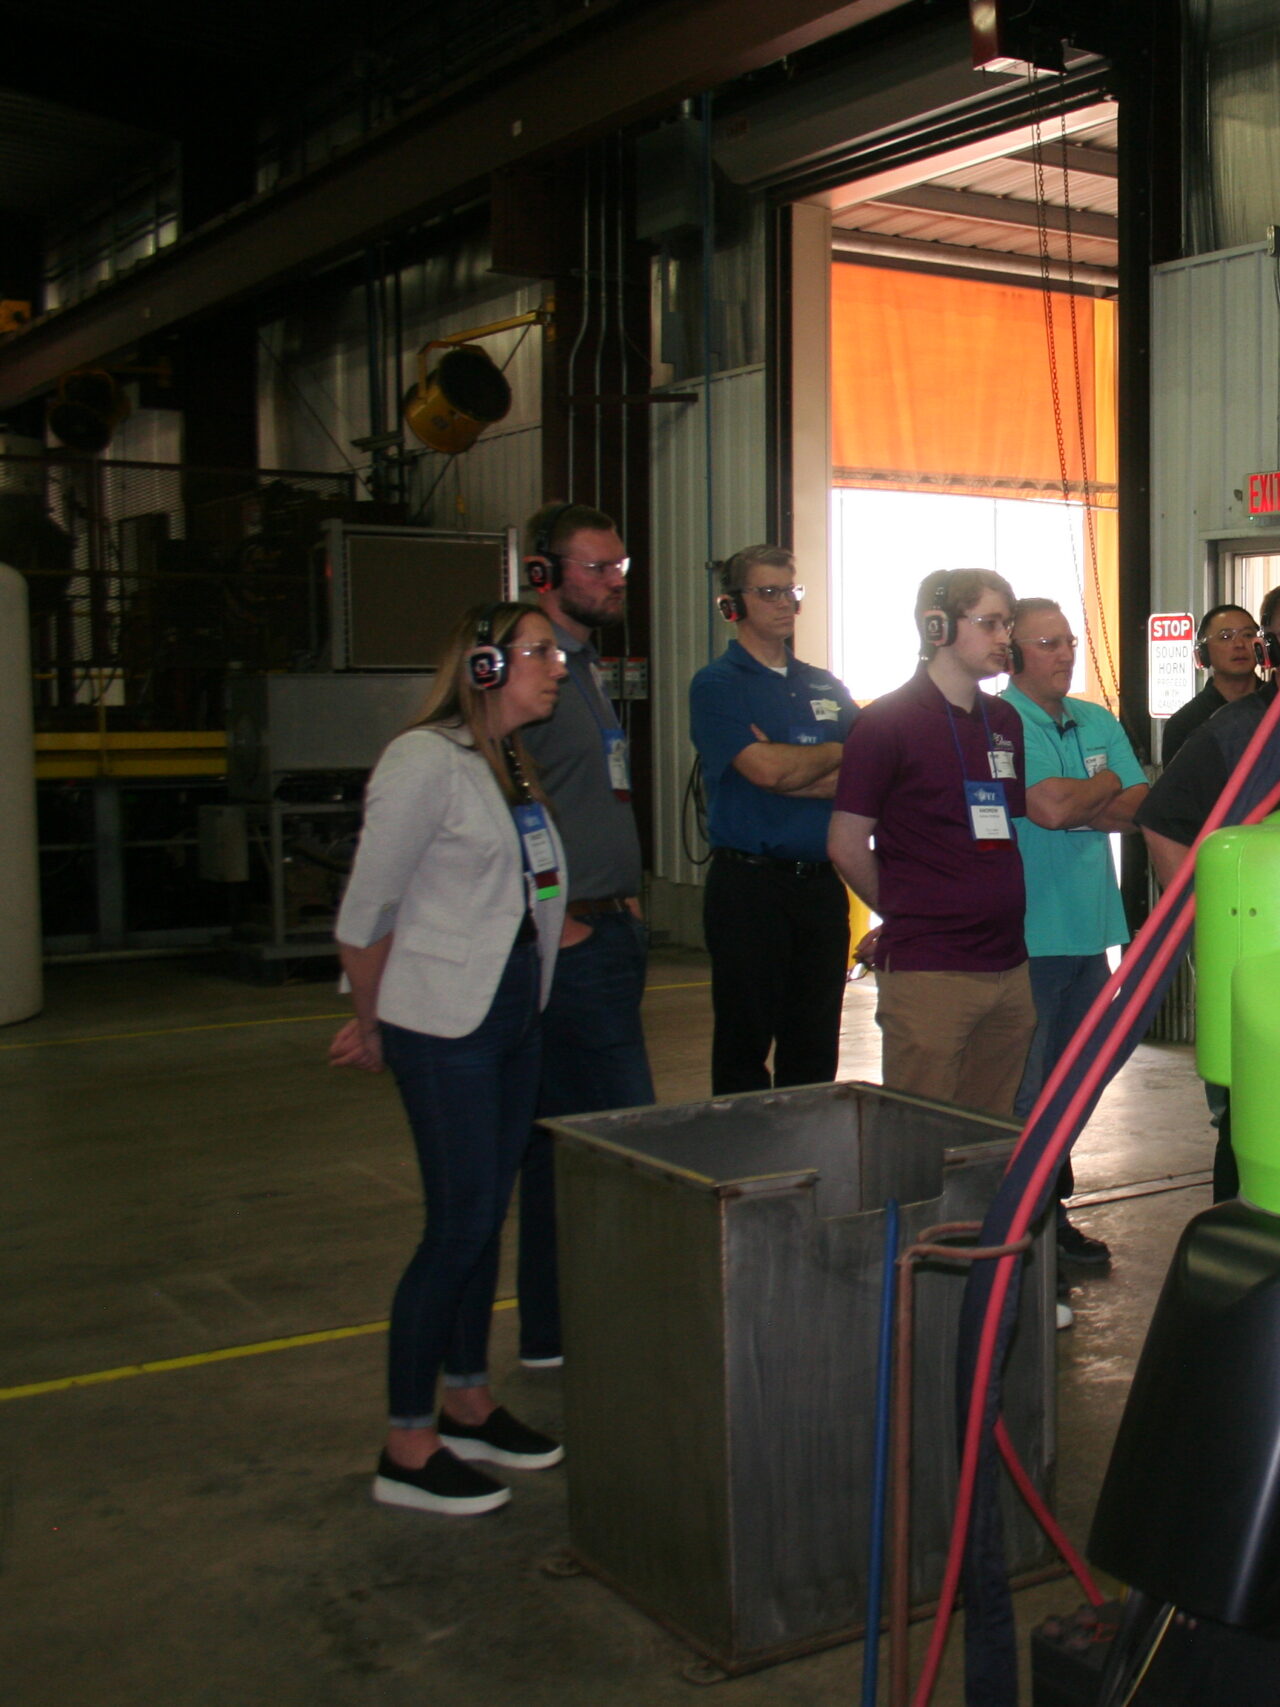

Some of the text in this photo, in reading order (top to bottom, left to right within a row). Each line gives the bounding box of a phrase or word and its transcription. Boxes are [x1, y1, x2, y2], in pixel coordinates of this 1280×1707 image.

[1153, 620, 1190, 637] STOP
[1155, 646, 1189, 658] SOUND
[1158, 663, 1186, 674] HORN
